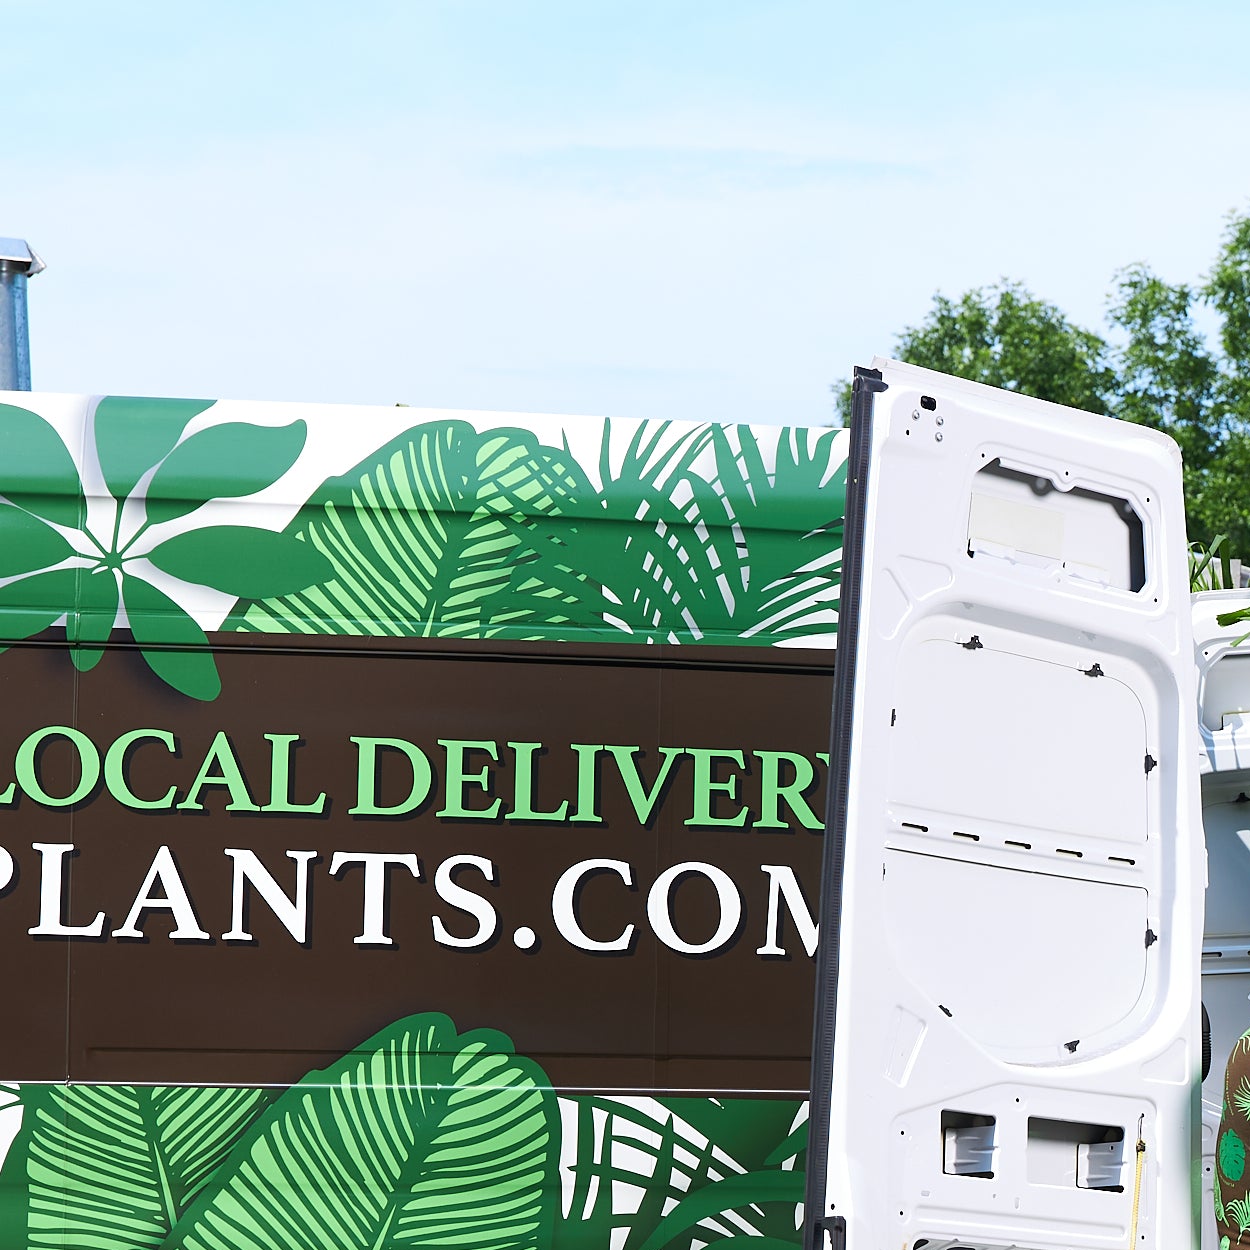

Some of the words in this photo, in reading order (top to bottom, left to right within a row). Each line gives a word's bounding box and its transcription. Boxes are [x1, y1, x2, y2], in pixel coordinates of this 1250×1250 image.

[0, 726, 326, 814] OCAL
[348, 735, 829, 829] DELIVER
[0, 842, 820, 957] LANTS.COM
